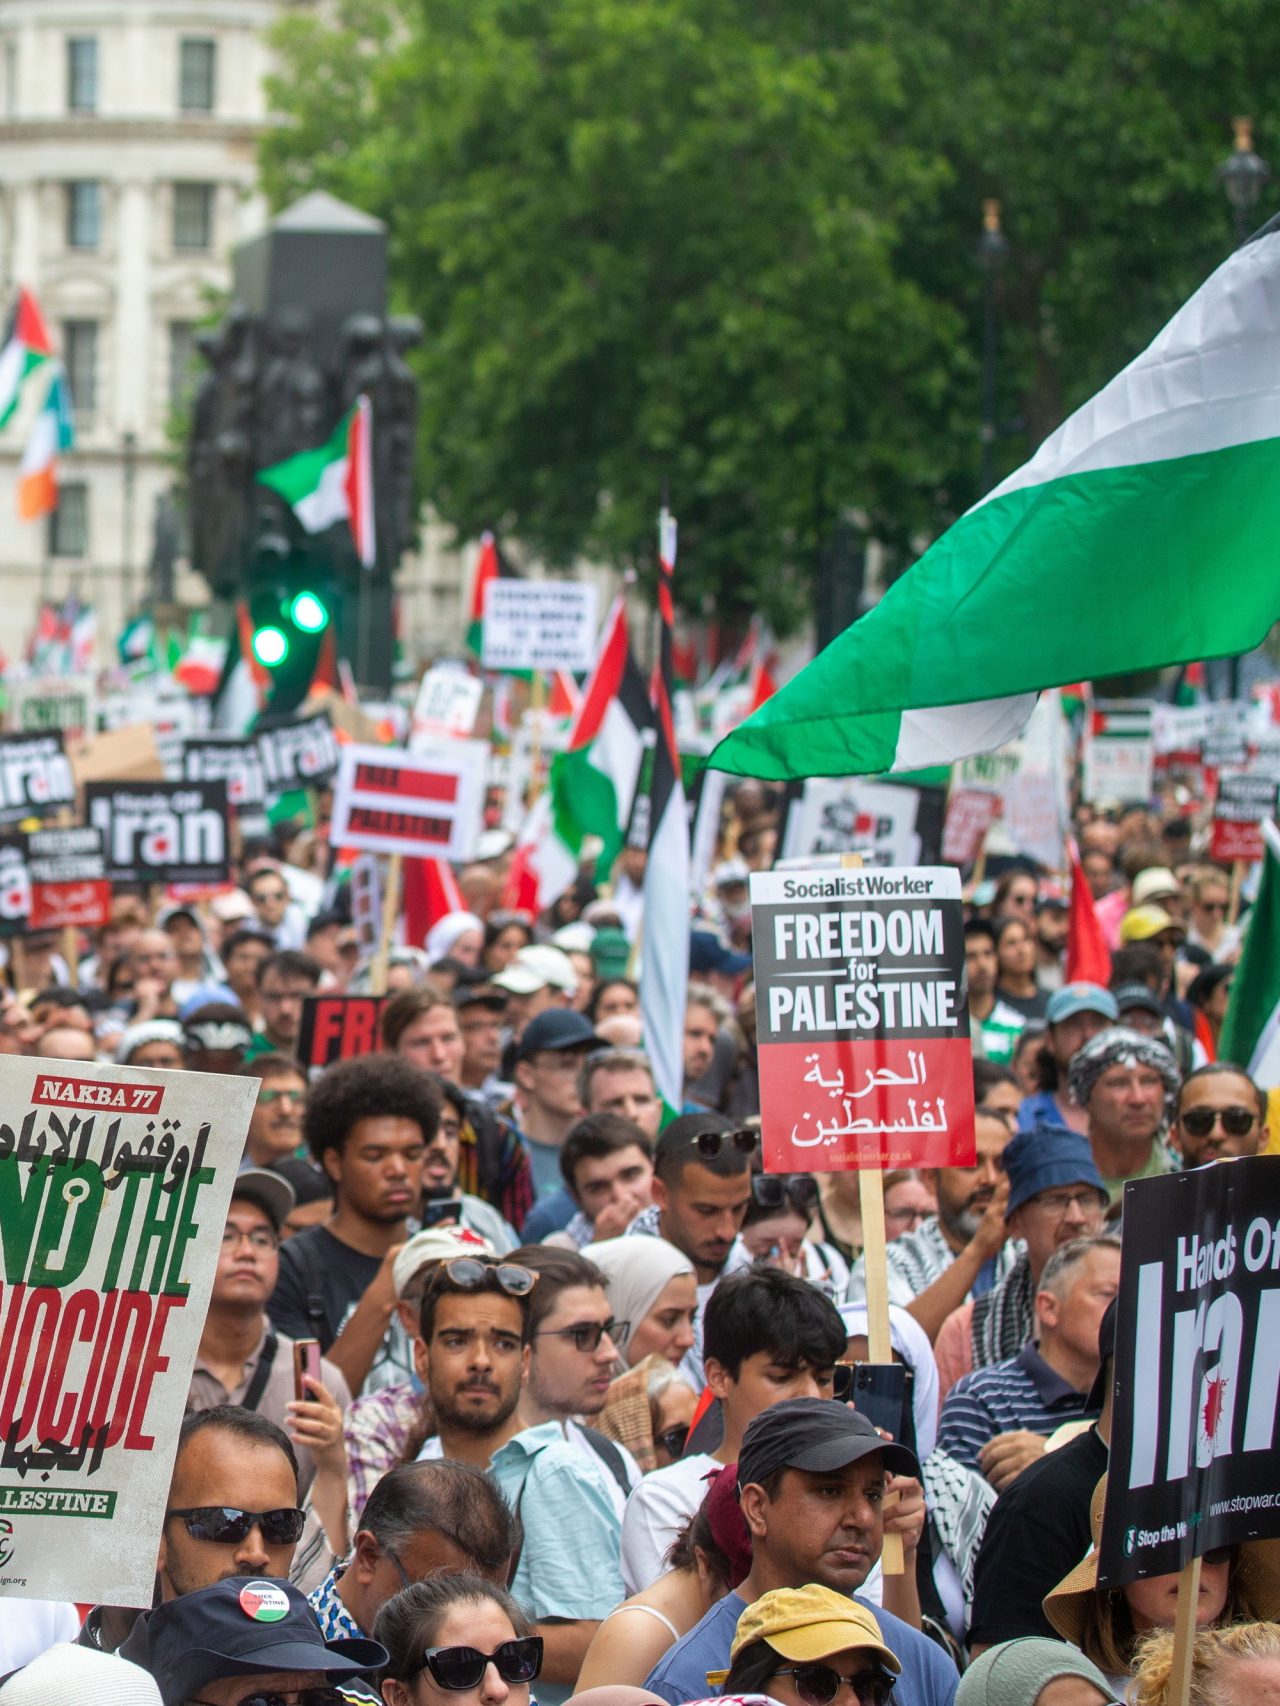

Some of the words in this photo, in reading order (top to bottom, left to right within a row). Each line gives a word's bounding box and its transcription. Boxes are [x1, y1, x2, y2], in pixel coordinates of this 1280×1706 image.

[774, 909, 945, 960] FREEDOM
[848, 958, 876, 980] for
[769, 981, 959, 1033] PALESTINE
[310, 999, 388, 1066] FR
[40, 1080, 127, 1108] NAKBA
[132, 1089, 157, 1108] 77
[803, 1050, 927, 1098] الحرية
[791, 1097, 948, 1147] لفلسطين
[100, 1166, 217, 1298] THE
[1176, 1224, 1237, 1292] Hands
[1137, 1527, 1160, 1549] Stop
[1160, 1524, 1176, 1542] the
